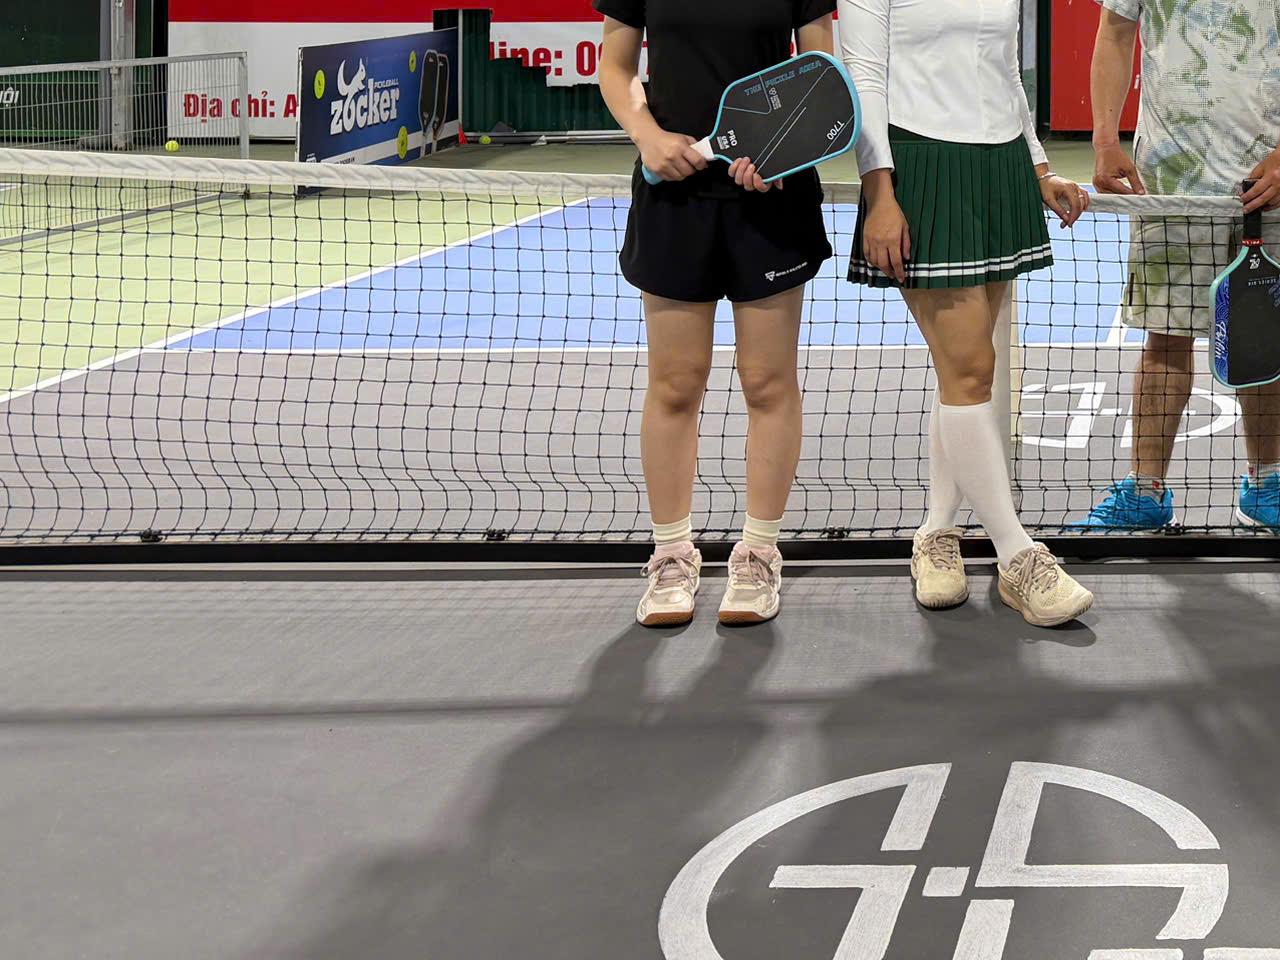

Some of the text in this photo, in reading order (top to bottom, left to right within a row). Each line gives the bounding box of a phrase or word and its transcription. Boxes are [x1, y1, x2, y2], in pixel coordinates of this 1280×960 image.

[183, 93, 223, 124] Địa
[330, 78, 399, 135] zocker
[727, 129, 738, 147] PRO
[826, 120, 845, 140] T700
